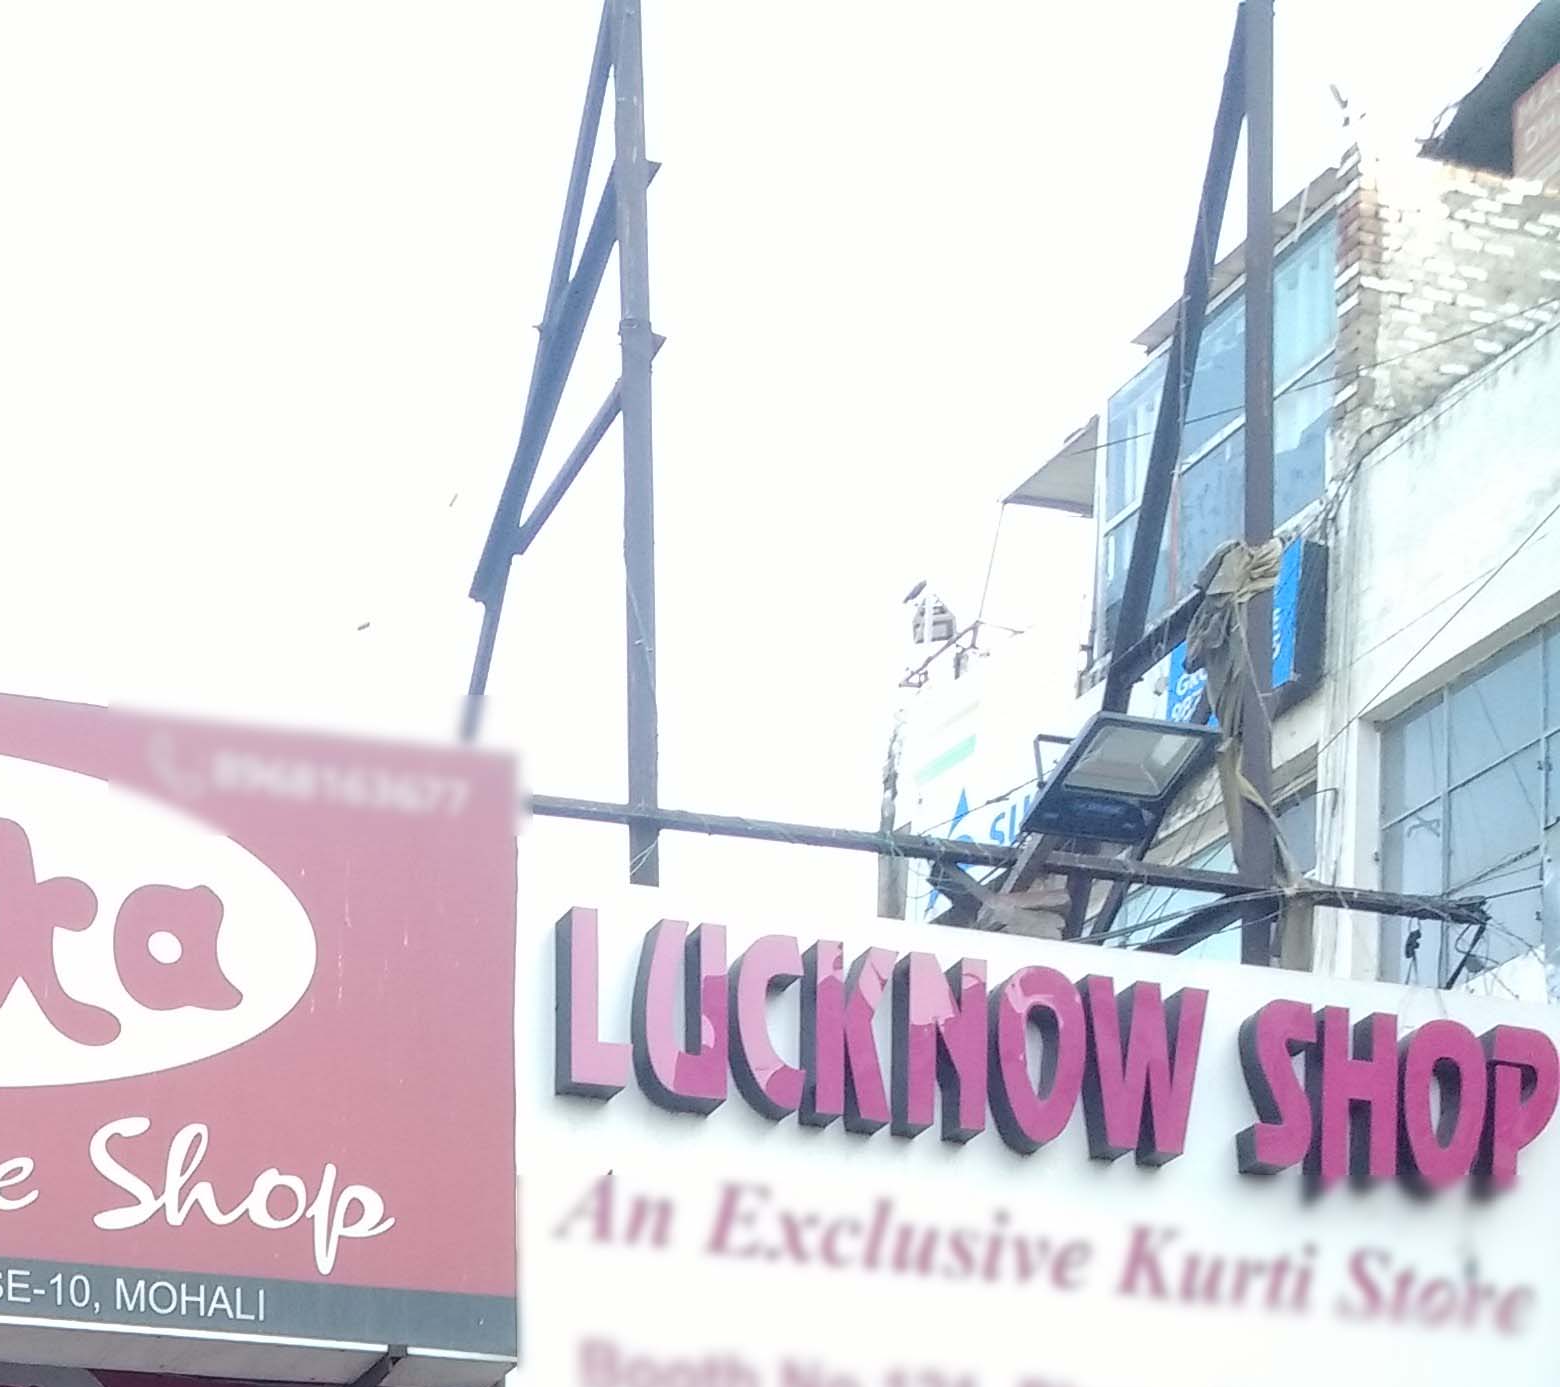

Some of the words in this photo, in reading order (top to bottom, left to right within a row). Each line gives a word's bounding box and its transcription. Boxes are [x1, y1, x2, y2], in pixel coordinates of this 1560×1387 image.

[554, 906, 1209, 1167] LUCKNOW
[1237, 997, 1560, 1194] SHOP
[90, 1116, 395, 1275] Shop
[553, 1172, 674, 1248] An
[707, 1182, 1092, 1291] Exclusive
[1117, 1223, 1317, 1314] Kurti
[1337, 1247, 1535, 1336] Store
[115, 1278, 265, 1320] MOHALI
